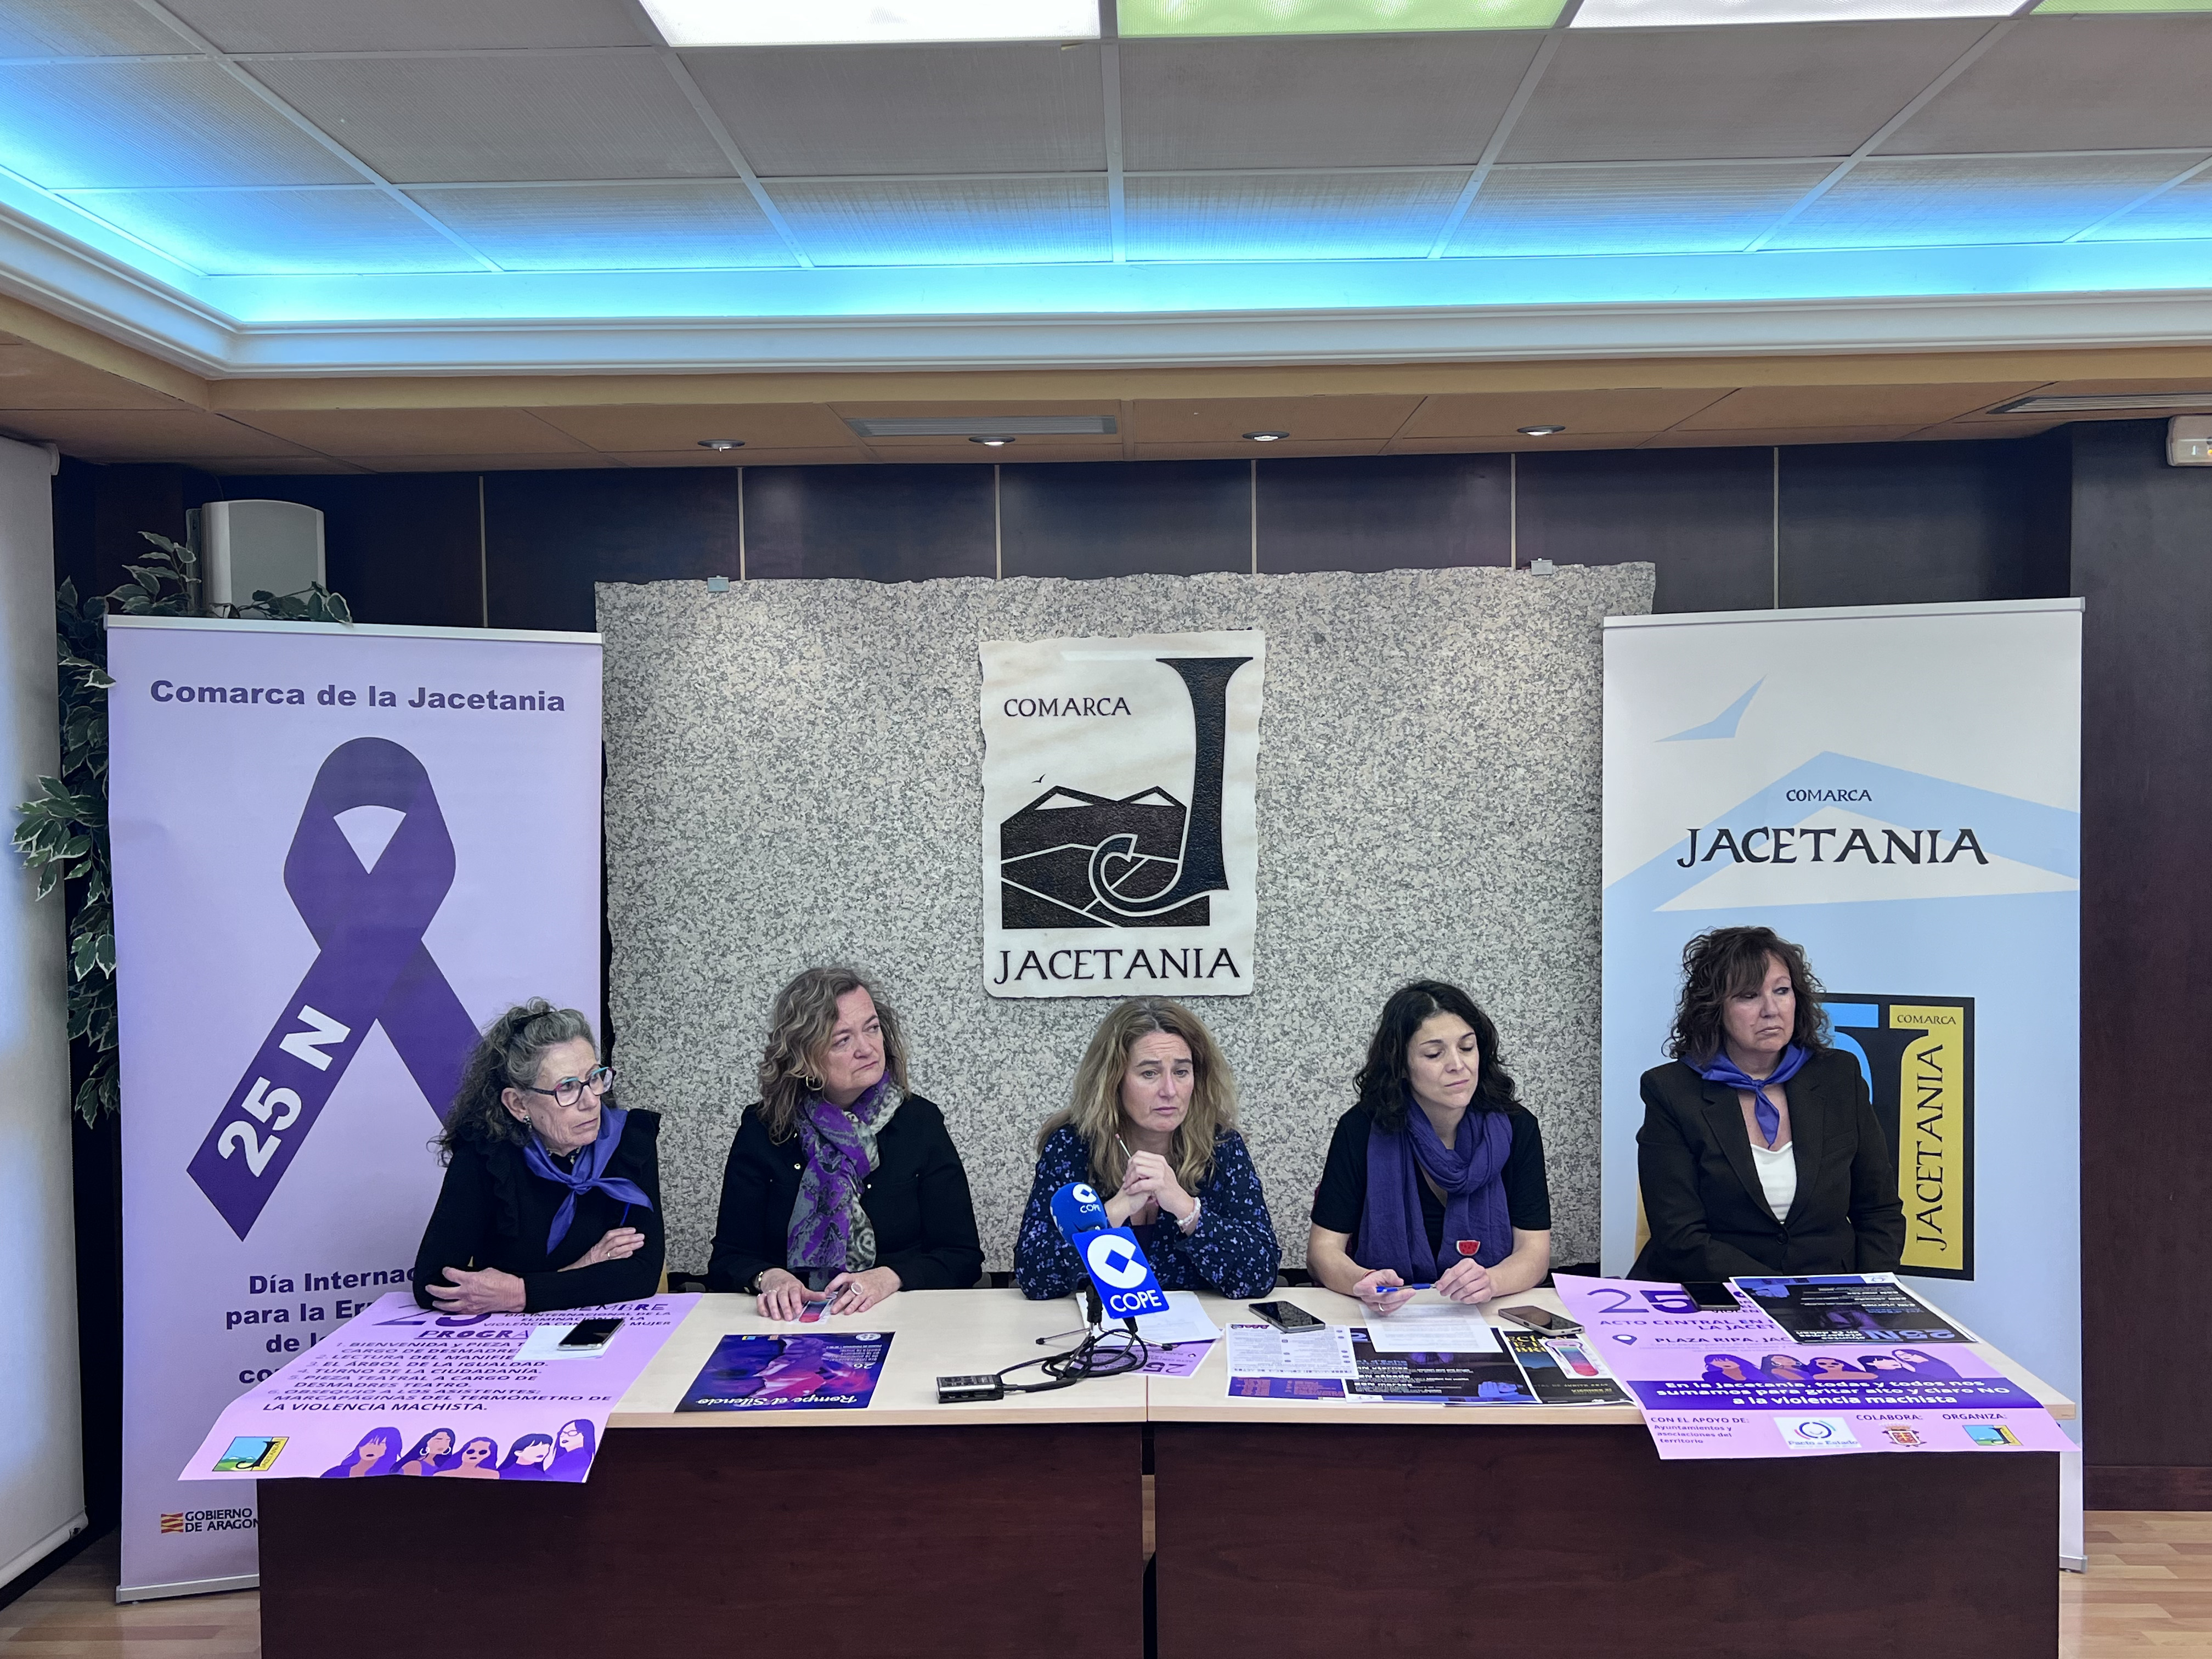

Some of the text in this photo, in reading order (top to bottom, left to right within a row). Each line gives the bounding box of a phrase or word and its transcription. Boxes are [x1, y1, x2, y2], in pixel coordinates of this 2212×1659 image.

[150, 680, 565, 712] Comarca de la Jacetania
[1003, 697, 1131, 717] COMARCA
[1786, 789, 1873, 803] COMARCA
[1677, 828, 1989, 867] JACETANIA
[994, 947, 1240, 985] JACETANIA
[1897, 1014, 1957, 1025] COMARCA
[218, 1005, 351, 1178] 25 N
[1915, 1043, 1945, 1252] JACETANIA
[250, 1274, 295, 1294] Día
[1110, 1289, 1162, 1313] COPE
[1587, 1288, 1701, 1314] 25
[226, 1308, 290, 1330] para
[300, 1304, 325, 1322] la
[266, 1334, 300, 1353] de
[239, 1368, 280, 1384] co
[791, 1394, 857, 1404] Rompe
[1733, 1395, 1958, 1405] a la violencia machista
[1805, 1387, 1859, 1396] gritar
[696, 1397, 768, 1406] Silencio
[185, 1508, 253, 1522] GOBIERNO
[185, 1522, 202, 1533] DE
